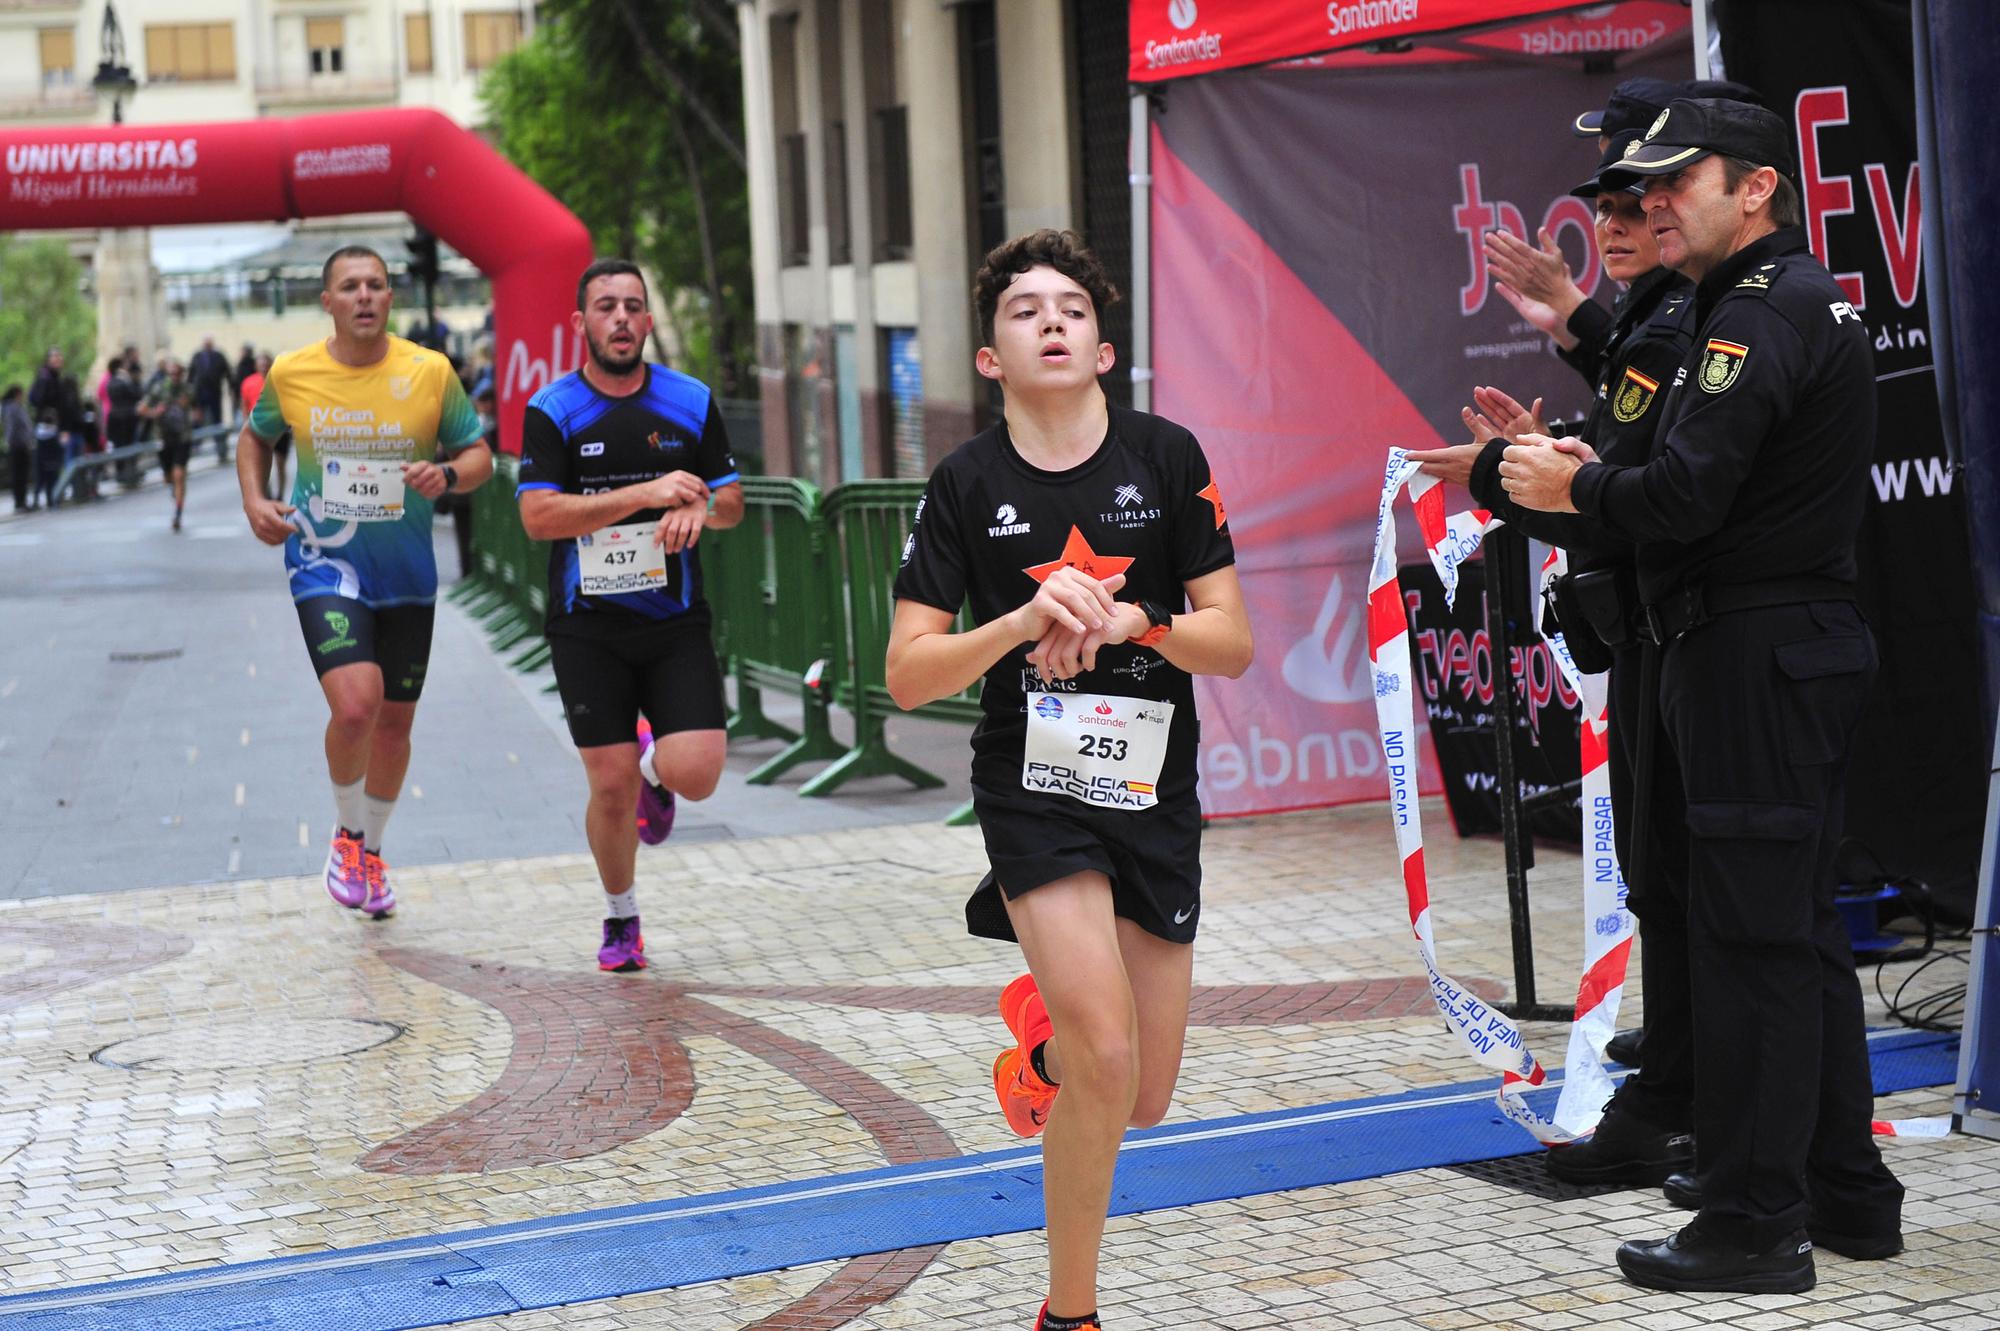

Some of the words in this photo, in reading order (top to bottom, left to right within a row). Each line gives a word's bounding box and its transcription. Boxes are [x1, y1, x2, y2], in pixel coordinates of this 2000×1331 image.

[1328, 0, 1419, 36] Santander
[1145, 30, 1222, 69] Santander
[6, 139, 197, 174] UNIVERSITAS
[11, 175, 81, 203] Miguel
[88, 171, 198, 199] Hernández
[1795, 85, 1921, 310] Ev
[1829, 302, 1861, 324] PO
[310, 406, 330, 421] IV
[332, 406, 374, 422] Gran
[310, 422, 374, 436] Carrera
[378, 421, 402, 435] del
[348, 483, 379, 497] 436
[324, 501, 385, 512] POLICIA
[324, 505, 401, 518] NACIONAL
[1100, 508, 1161, 522] TEJIPLAST
[988, 522, 1031, 537] VIATOR
[1120, 521, 1145, 529] FABRIC
[604, 550, 637, 565] 437
[583, 572, 648, 583] POLICIA
[583, 577, 665, 592] NACIONAL
[1078, 714, 1128, 729] Santander
[1078, 734, 1129, 761] 253
[1384, 730, 1404, 758] NO
[1028, 762, 1128, 791] POLICIA
[1026, 775, 1151, 807] NACIONAL
[1594, 796, 1612, 850] PASAR
[1596, 858, 1612, 882] NO
[1461, 997, 1487, 1021] DE
[1468, 1029, 1496, 1055] NO
